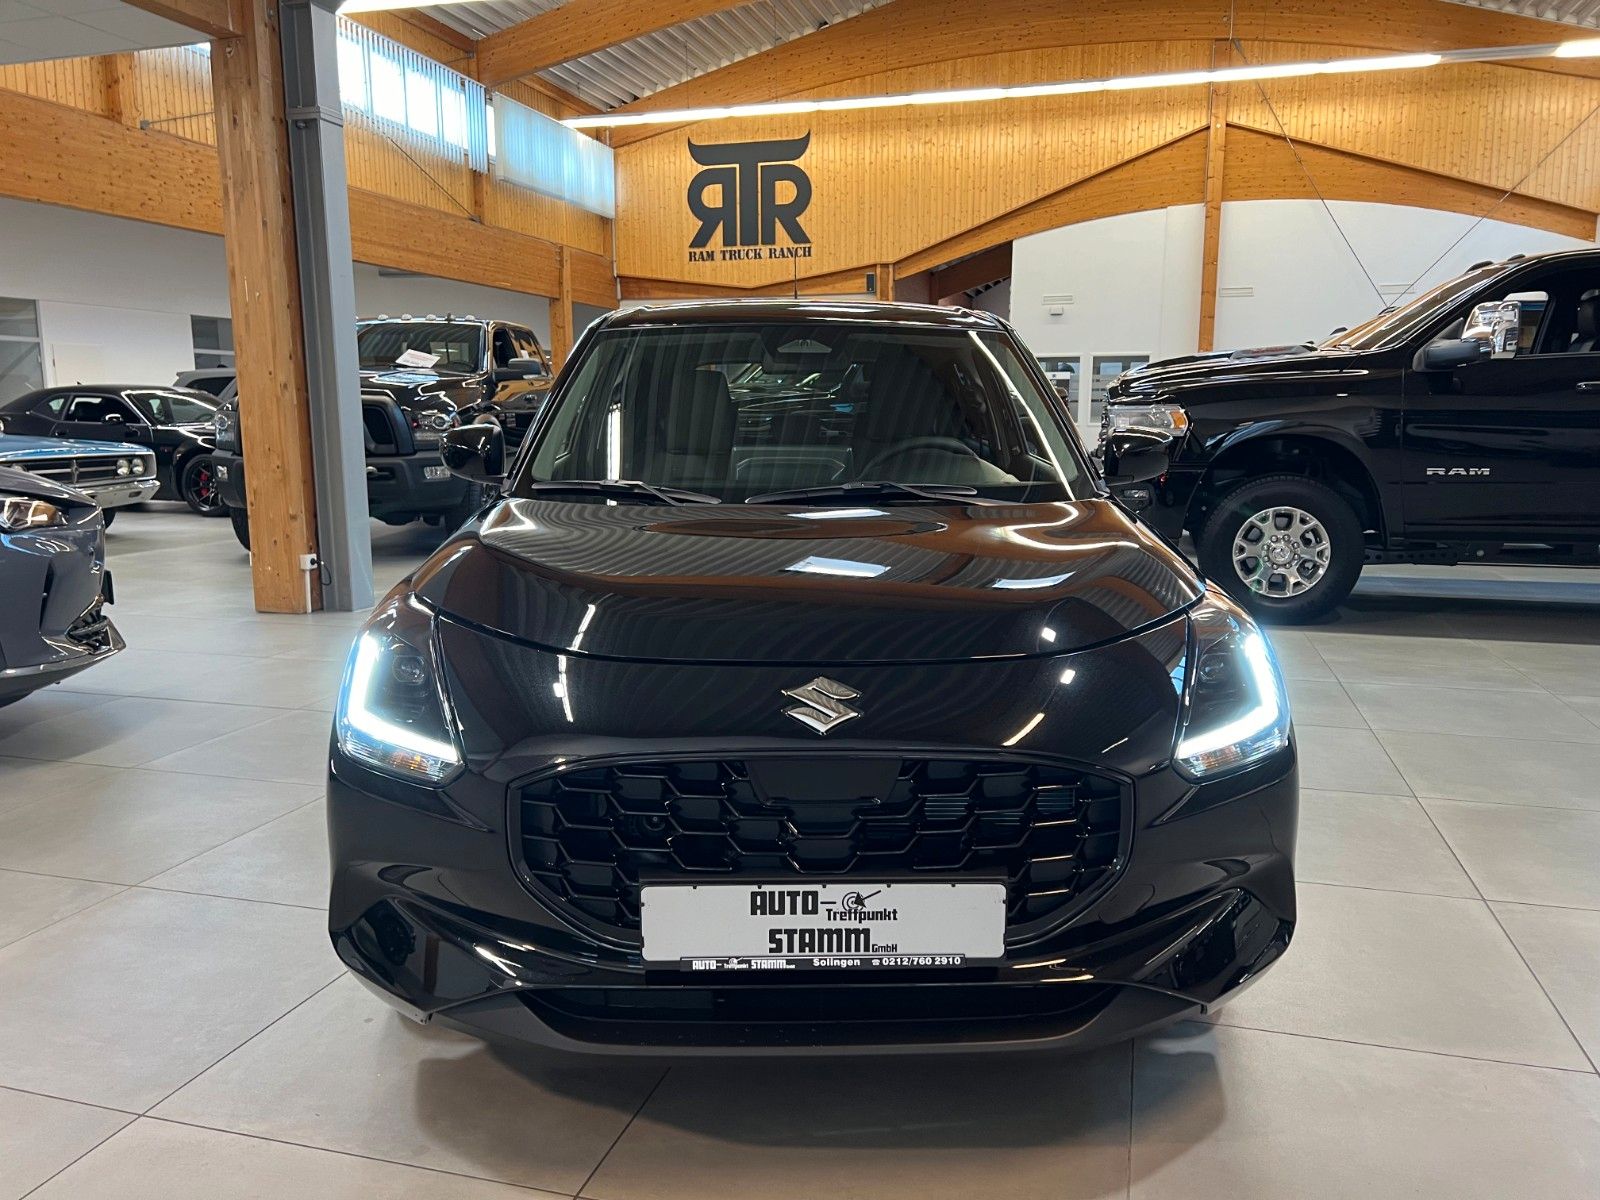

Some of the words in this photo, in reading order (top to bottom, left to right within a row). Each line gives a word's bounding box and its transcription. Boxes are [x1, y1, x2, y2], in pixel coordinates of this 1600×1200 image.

[688, 250, 715, 262] RAM
[720, 248, 762, 260] TRUCK
[768, 246, 812, 259] RANCH
[1426, 467, 1490, 475] RAM
[826, 908, 898, 924] Treffpunkt
[768, 928, 871, 954] STAMM
[871, 943, 898, 953] GmbH
[750, 959, 786, 969] STAMM
[813, 958, 861, 968] Solingen
[882, 957, 932, 966] 0212/760
[934, 957, 961, 965] 2910
